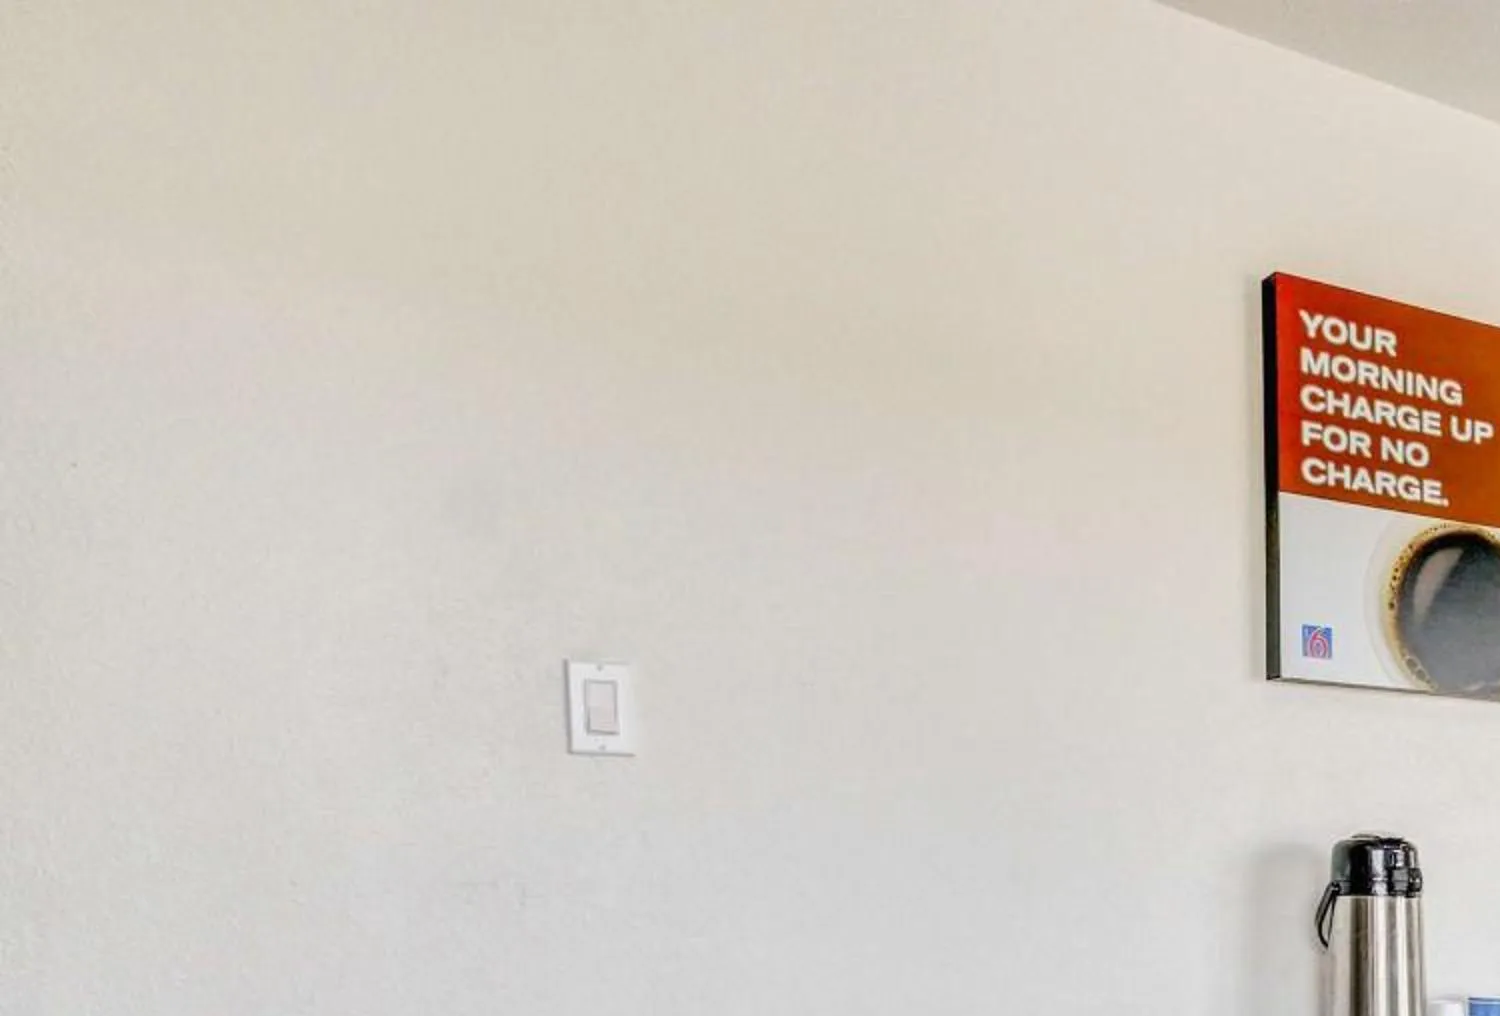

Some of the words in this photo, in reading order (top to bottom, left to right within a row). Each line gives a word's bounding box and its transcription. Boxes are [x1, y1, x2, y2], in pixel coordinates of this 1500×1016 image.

[1299, 309, 1398, 358] YOUR
[1300, 347, 1463, 407] MORNING
[1300, 385, 1443, 437] CHARGE
[1450, 416, 1495, 445] UP
[1300, 420, 1372, 459] FOR
[1380, 436, 1430, 468] NO
[1300, 457, 1450, 507] CHARGE.
